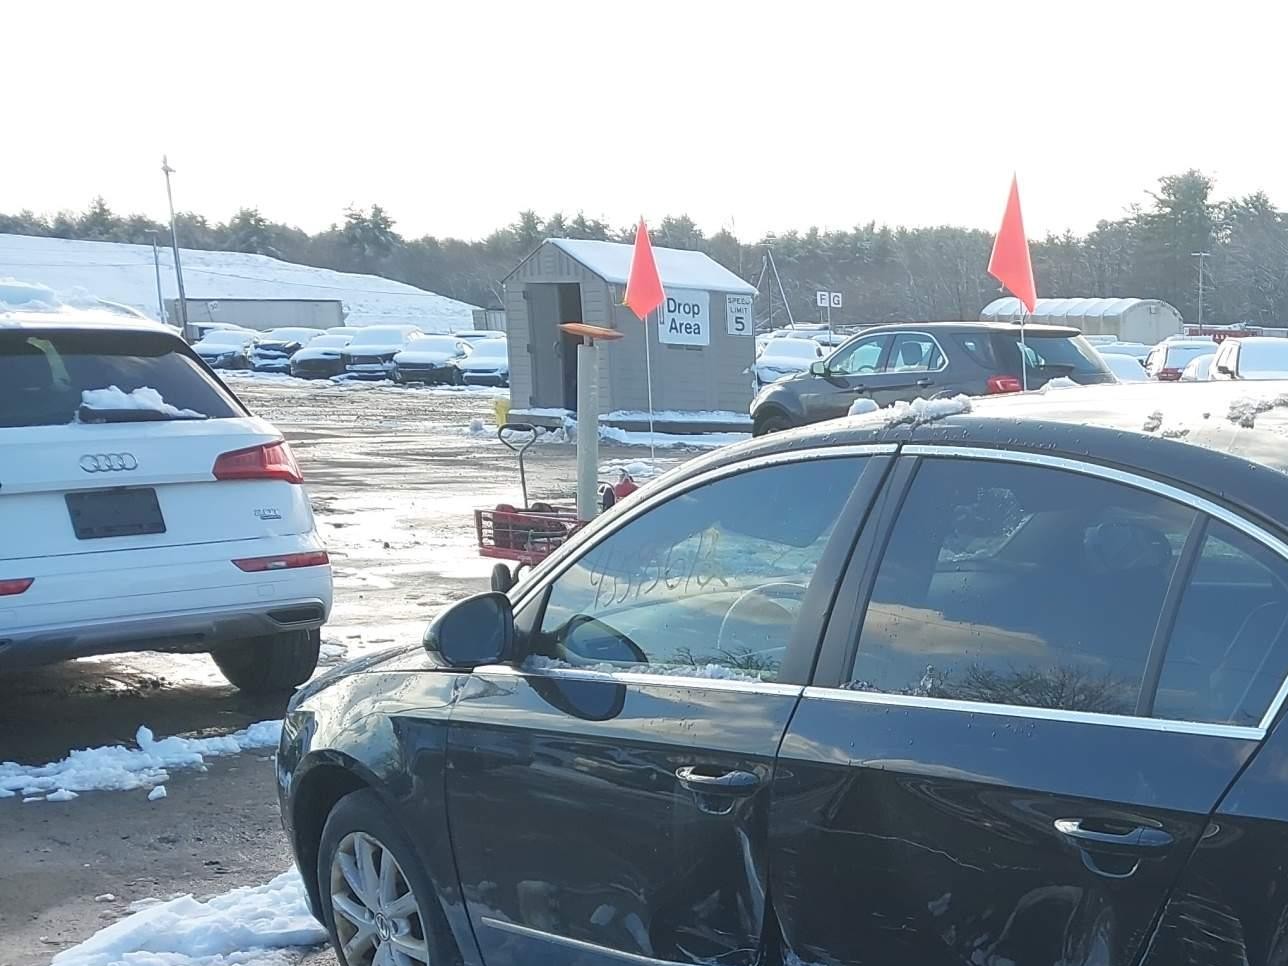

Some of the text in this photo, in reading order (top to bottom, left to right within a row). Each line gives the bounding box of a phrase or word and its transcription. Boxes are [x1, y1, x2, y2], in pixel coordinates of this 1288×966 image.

[728, 297, 751, 305] SPEED
[820, 293, 827, 304] F
[832, 294, 840, 305] G
[667, 297, 700, 318] Drop
[669, 318, 701, 335] Area
[735, 316, 745, 331] 5
